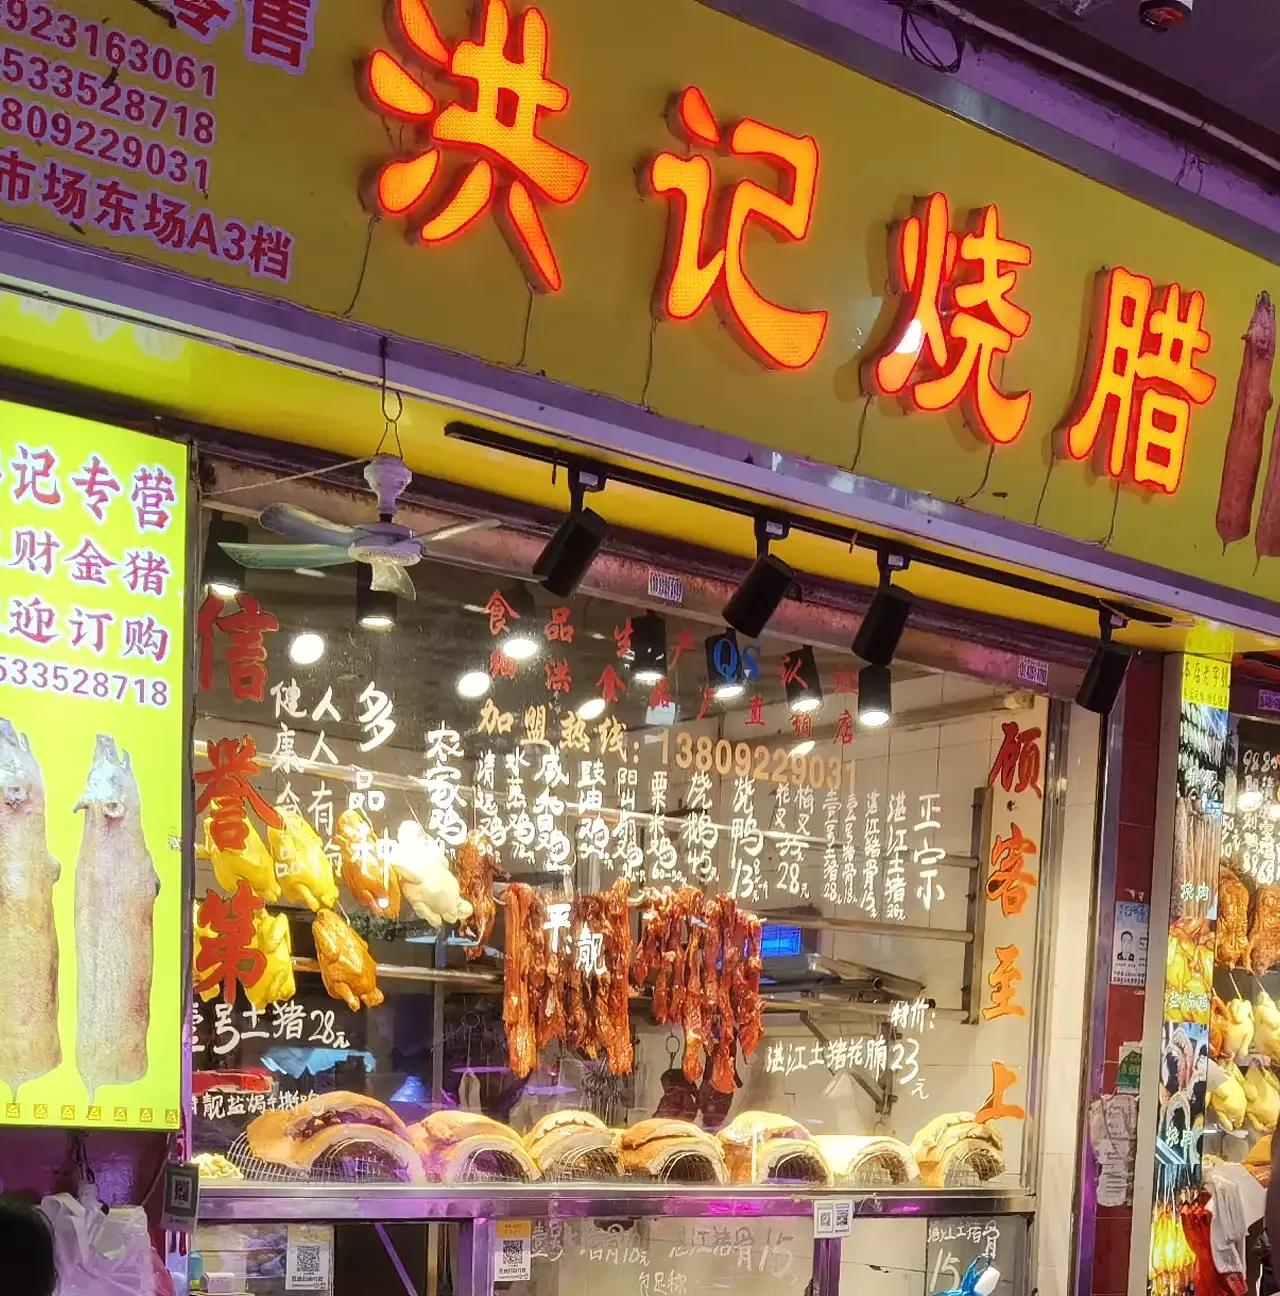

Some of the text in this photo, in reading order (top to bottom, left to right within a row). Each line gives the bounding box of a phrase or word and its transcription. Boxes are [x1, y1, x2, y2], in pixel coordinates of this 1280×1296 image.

[366, 0, 1218, 496] 洪记烧腊
[659, 728, 858, 795] 13809229031
[912, 792, 948, 911] 正宗
[974, 721, 1043, 1126] 顾客至上
